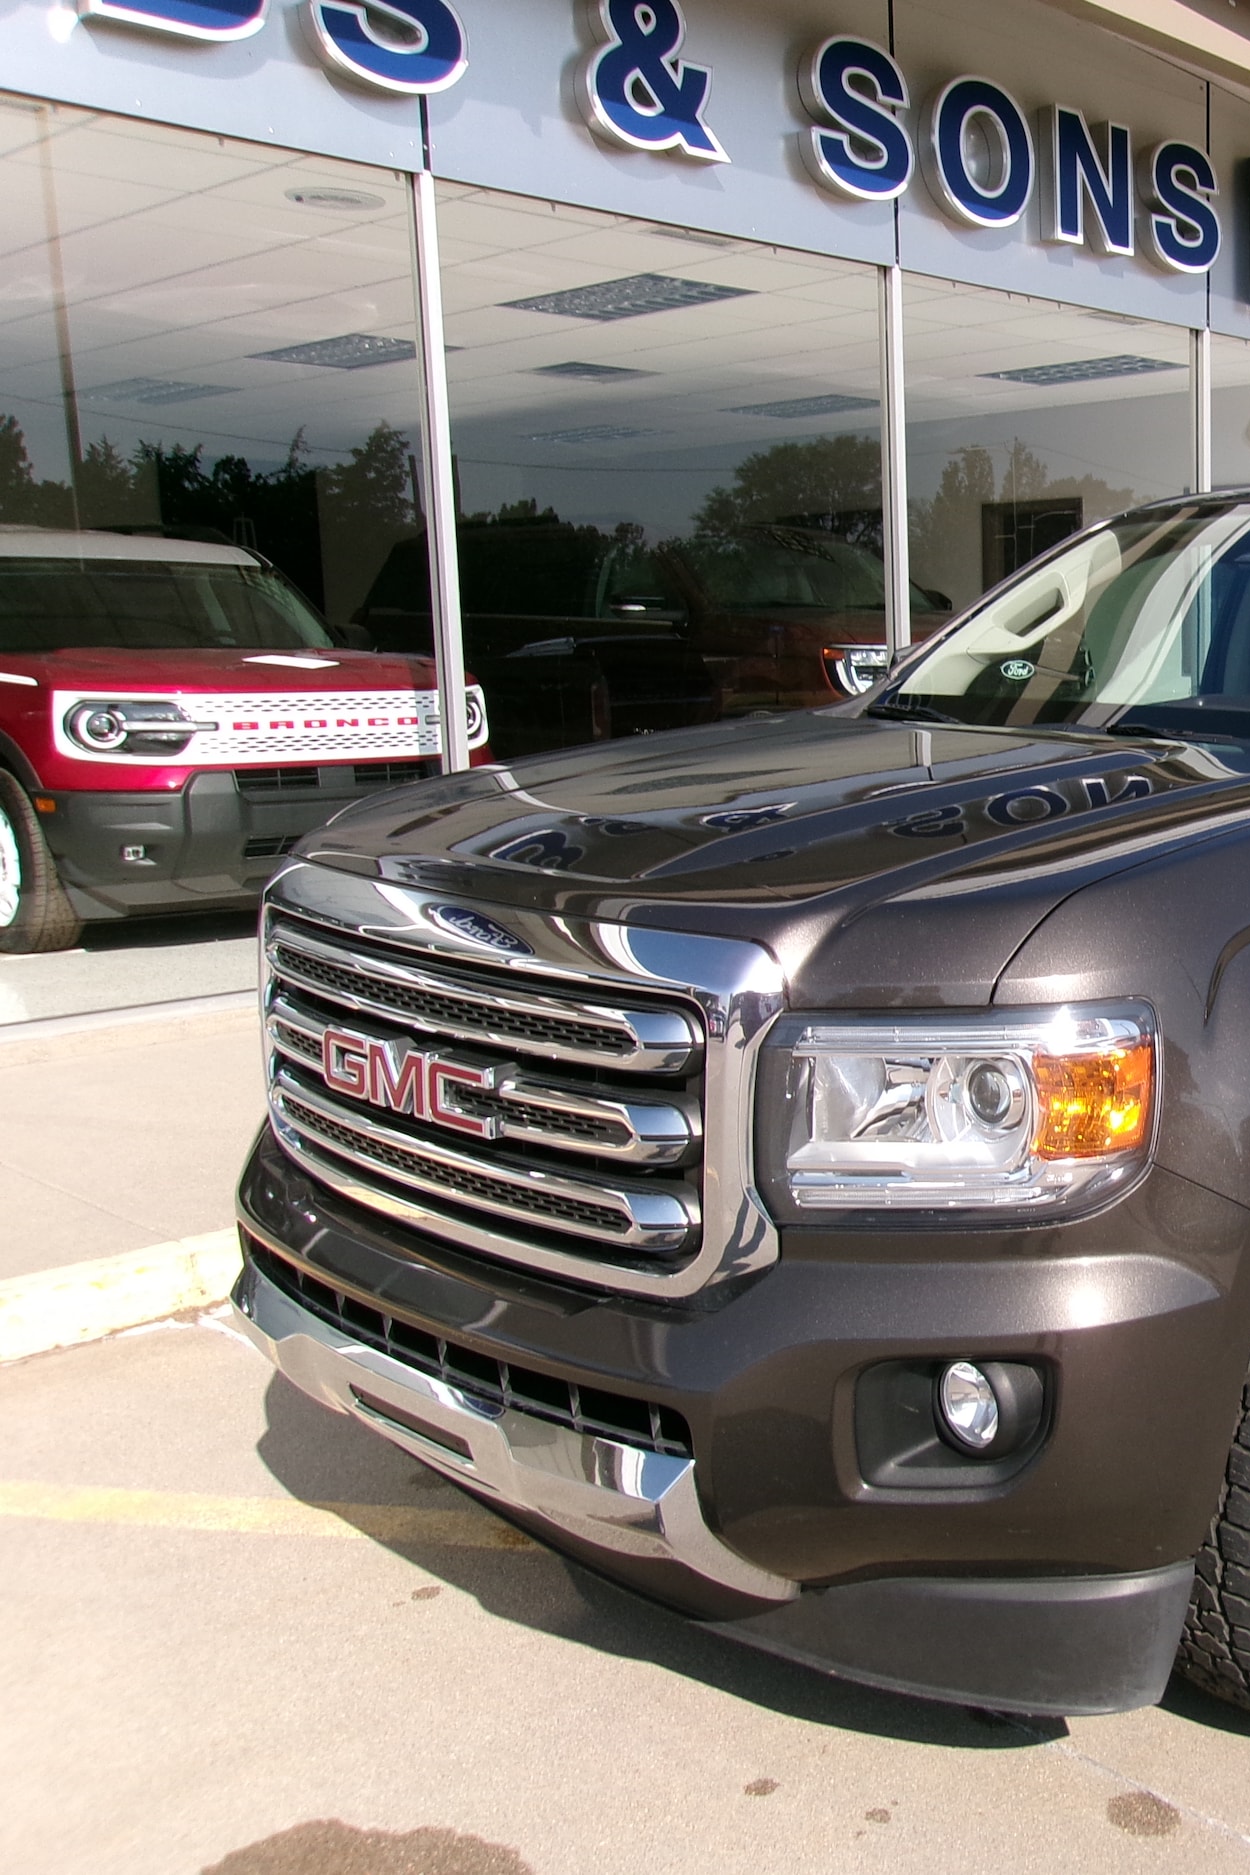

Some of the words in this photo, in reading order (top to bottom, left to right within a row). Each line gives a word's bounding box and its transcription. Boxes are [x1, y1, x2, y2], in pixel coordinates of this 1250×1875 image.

[584, 0, 731, 163] &
[800, 33, 1222, 274] SONS
[232, 716, 419, 731] BRONCO
[322, 1024, 502, 1140] GMC
